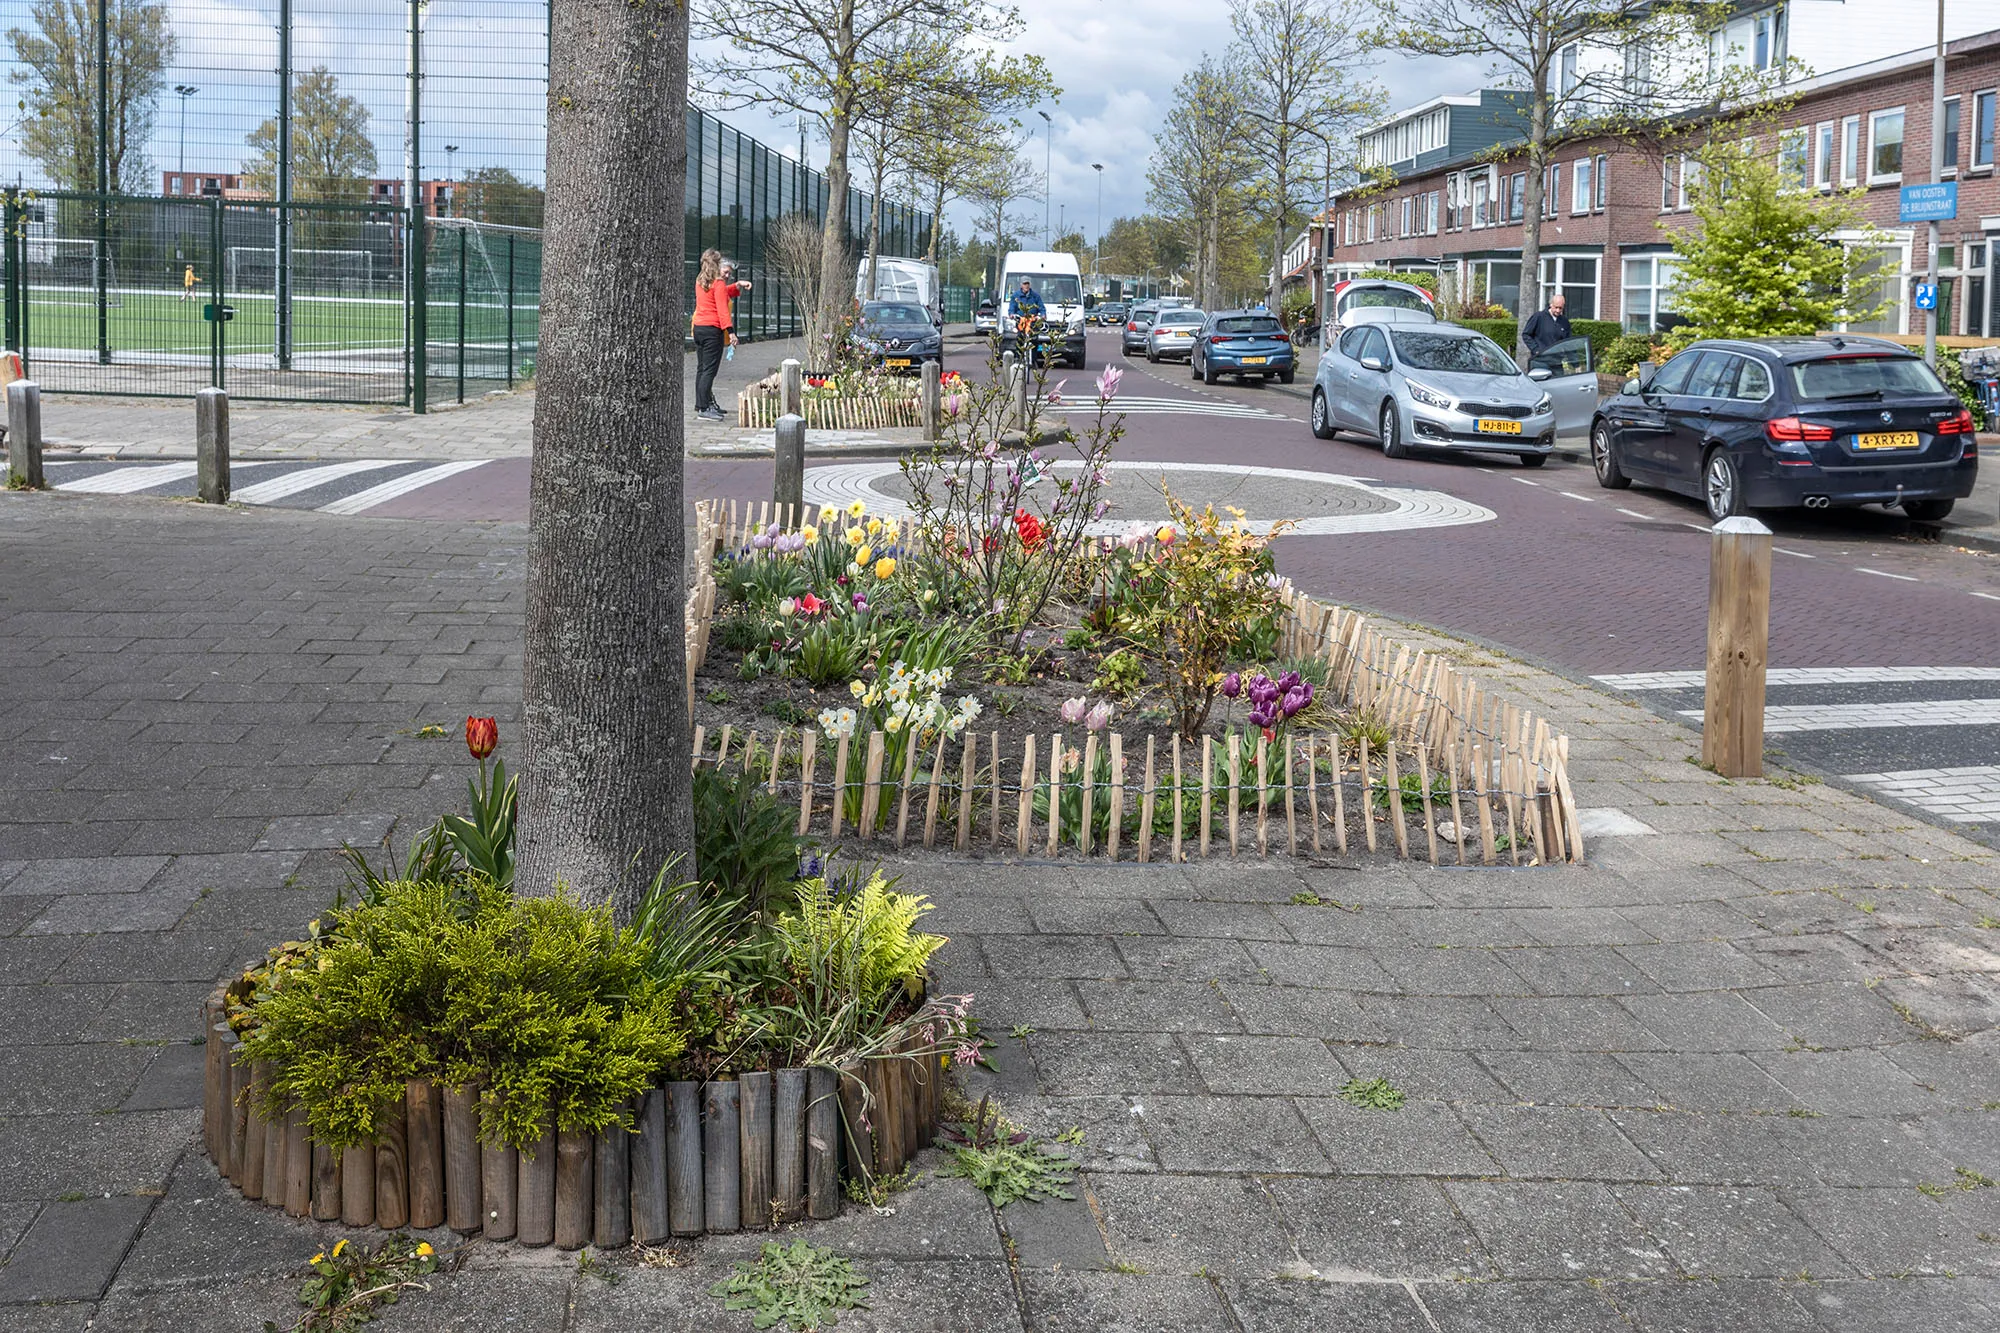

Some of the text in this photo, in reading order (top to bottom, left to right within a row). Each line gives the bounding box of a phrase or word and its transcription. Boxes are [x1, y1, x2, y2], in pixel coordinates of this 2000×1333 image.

[1908, 187, 1946, 199] VAN OOSTEN
[1901, 202, 1910, 213] DE
[1917, 286, 1926, 297] P
[1483, 421, 1516, 431] HJ-811-F
[1862, 433, 1915, 446] 4-XRX-22
